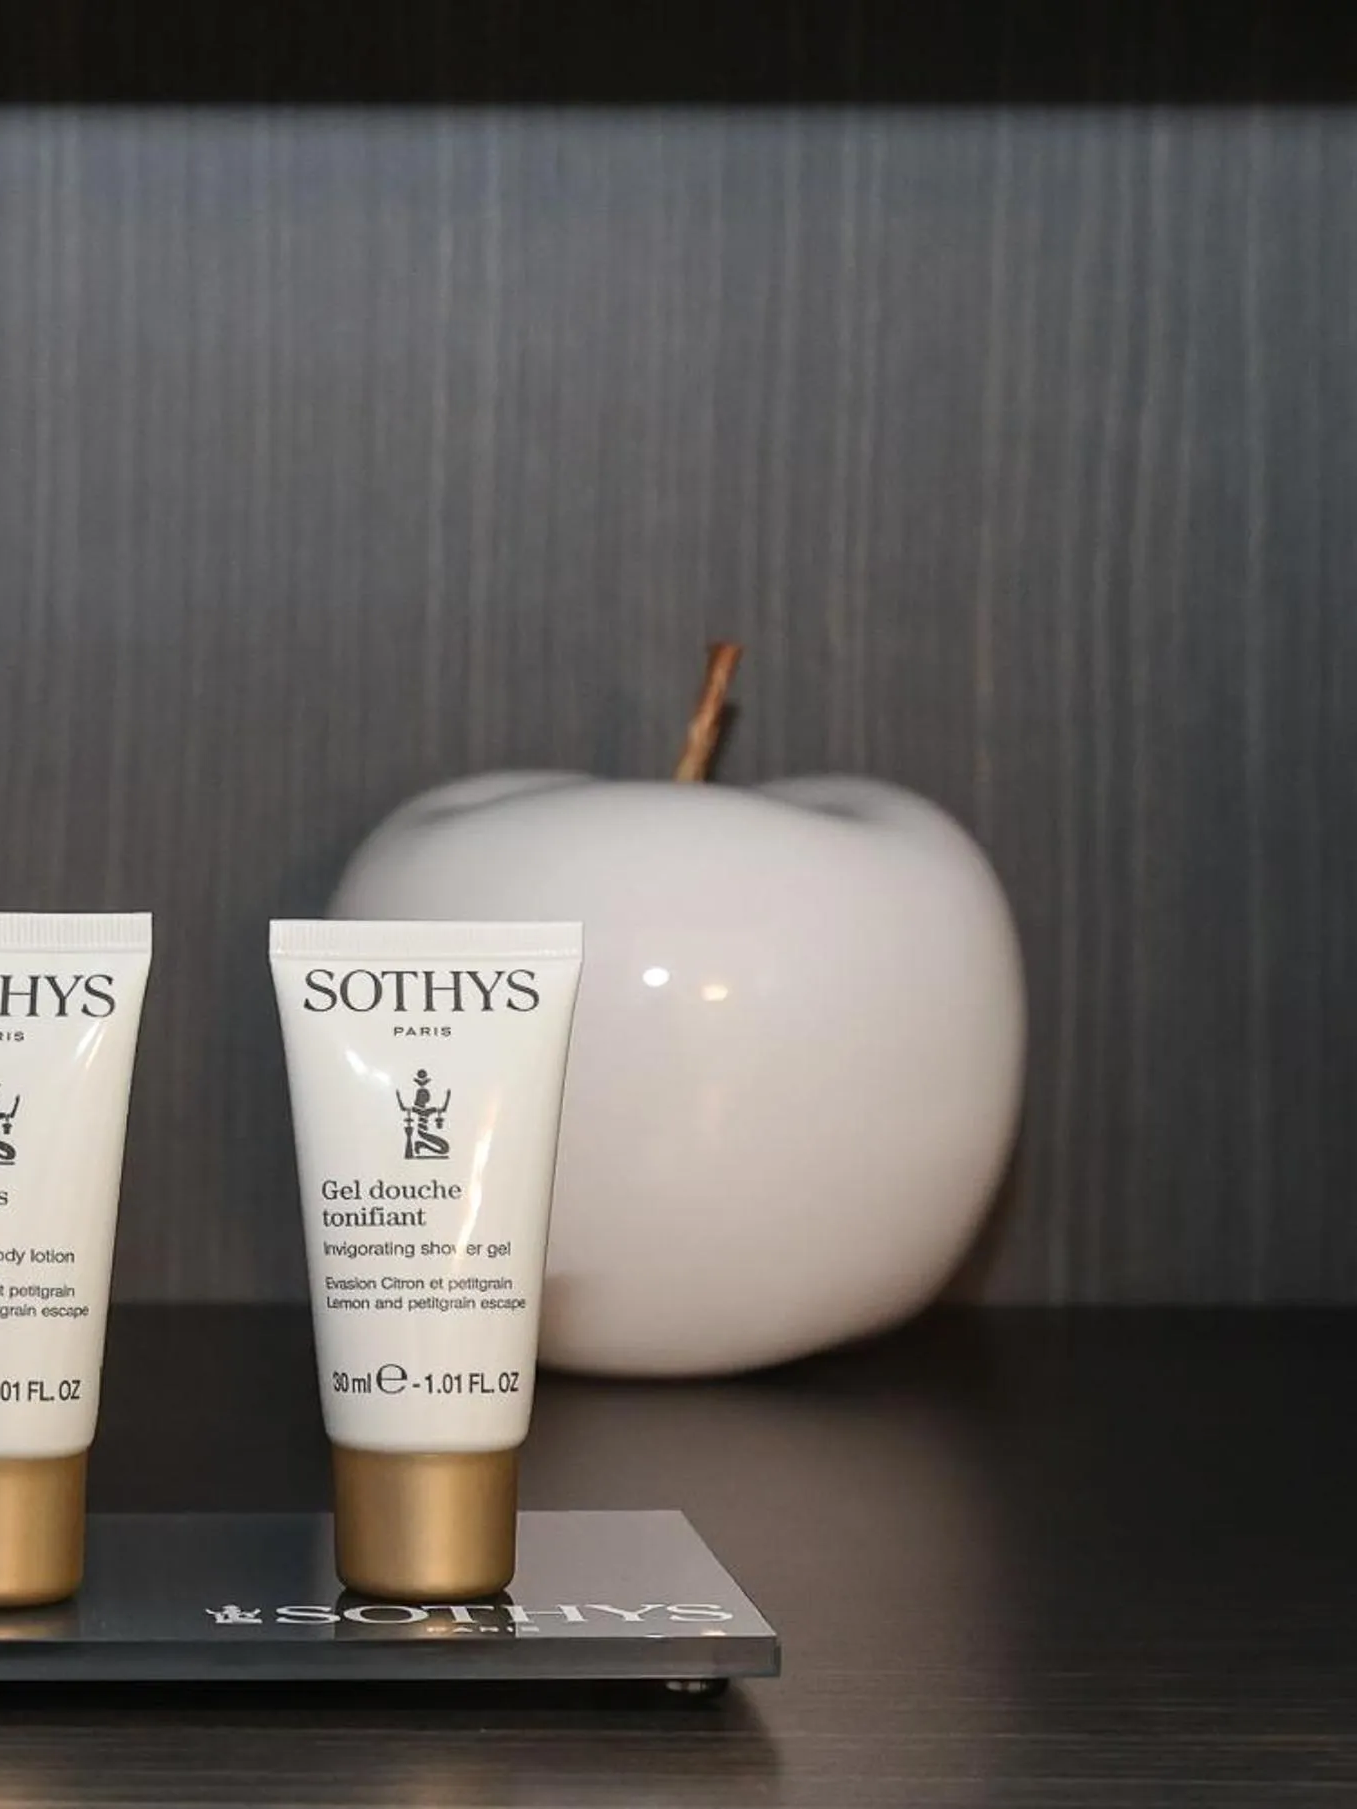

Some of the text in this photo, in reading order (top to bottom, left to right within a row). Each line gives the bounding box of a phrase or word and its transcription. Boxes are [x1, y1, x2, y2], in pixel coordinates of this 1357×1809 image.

[302, 968, 540, 1014] SOTHYS
[393, 1026, 452, 1037] PARIS
[321, 1179, 462, 1200] Gel douche
[322, 1206, 427, 1228] tonifiant
[30, 1249, 75, 1264] lotion
[323, 1241, 511, 1259] Invigorating shoer gel
[9, 1284, 76, 1300] petitgrain
[325, 1276, 513, 1292] Evasion Citron et petitgrain
[41, 1305, 89, 1318] escape
[326, 1296, 526, 1312] Lemon and petitgrain escape
[28, 1380, 55, 1402] FL.
[59, 1379, 81, 1401] OZ
[332, 1370, 349, 1392] 30
[352, 1373, 371, 1394] ml
[469, 1372, 495, 1394] FL.
[498, 1371, 519, 1393] OZ
[274, 1603, 734, 1625] SOTHYS
